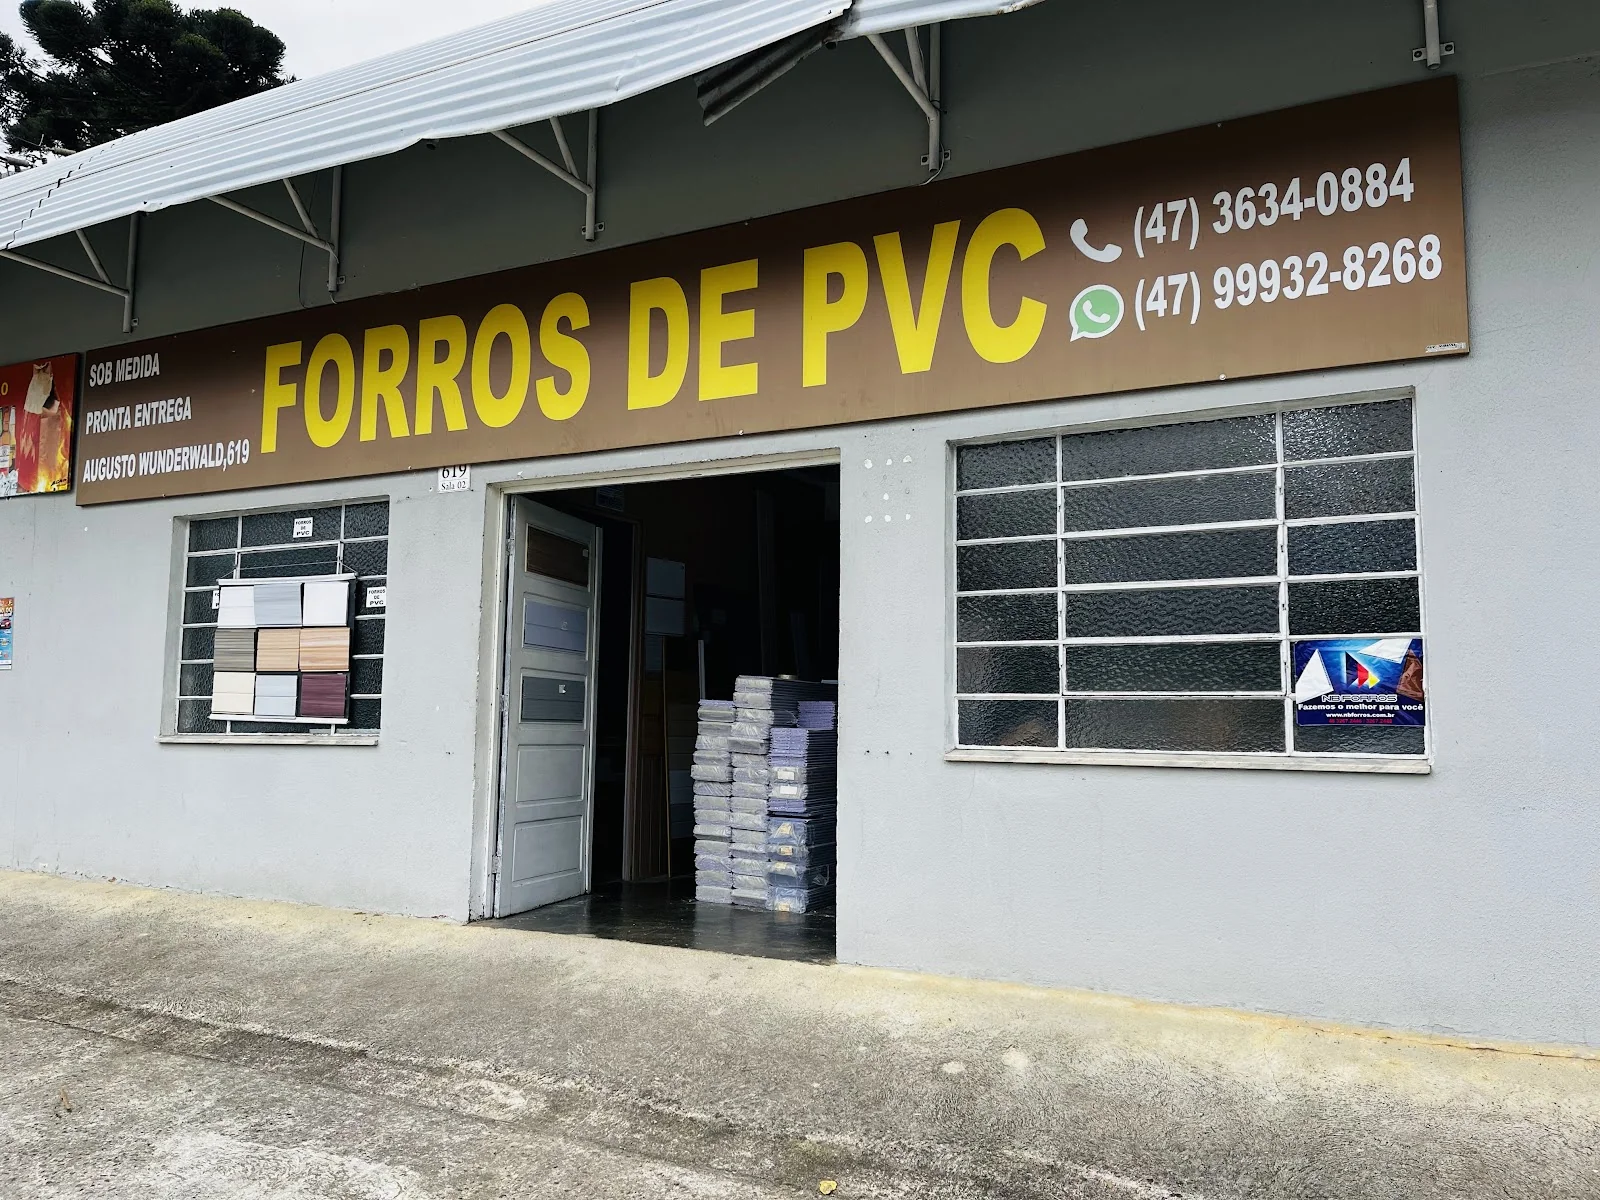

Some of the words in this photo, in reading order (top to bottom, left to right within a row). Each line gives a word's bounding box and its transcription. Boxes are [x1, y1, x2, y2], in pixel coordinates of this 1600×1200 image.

[1133, 197, 1200, 258] (47)
[1212, 157, 1414, 234] 3634-0884
[1134, 271, 1201, 331] (47)
[1213, 233, 1443, 309] 99932-8268
[261, 292, 592, 453] FORROS
[627, 258, 759, 410] DE
[802, 207, 1048, 388] PVC
[89, 361, 113, 387] SOB
[115, 353, 160, 382] MEDIDA
[85, 407, 132, 435] PRONTA
[134, 396, 192, 428] ENTREGA
[82, 453, 136, 483] AUGUSTO
[138, 438, 250, 476] WUNDERWALD,619
[442, 464, 467, 479] 619
[1341, 693, 1398, 703] FORROS
[1345, 703, 1377, 711] melhor
[1379, 704, 1400, 712] para
[1401, 703, 1424, 711] você
